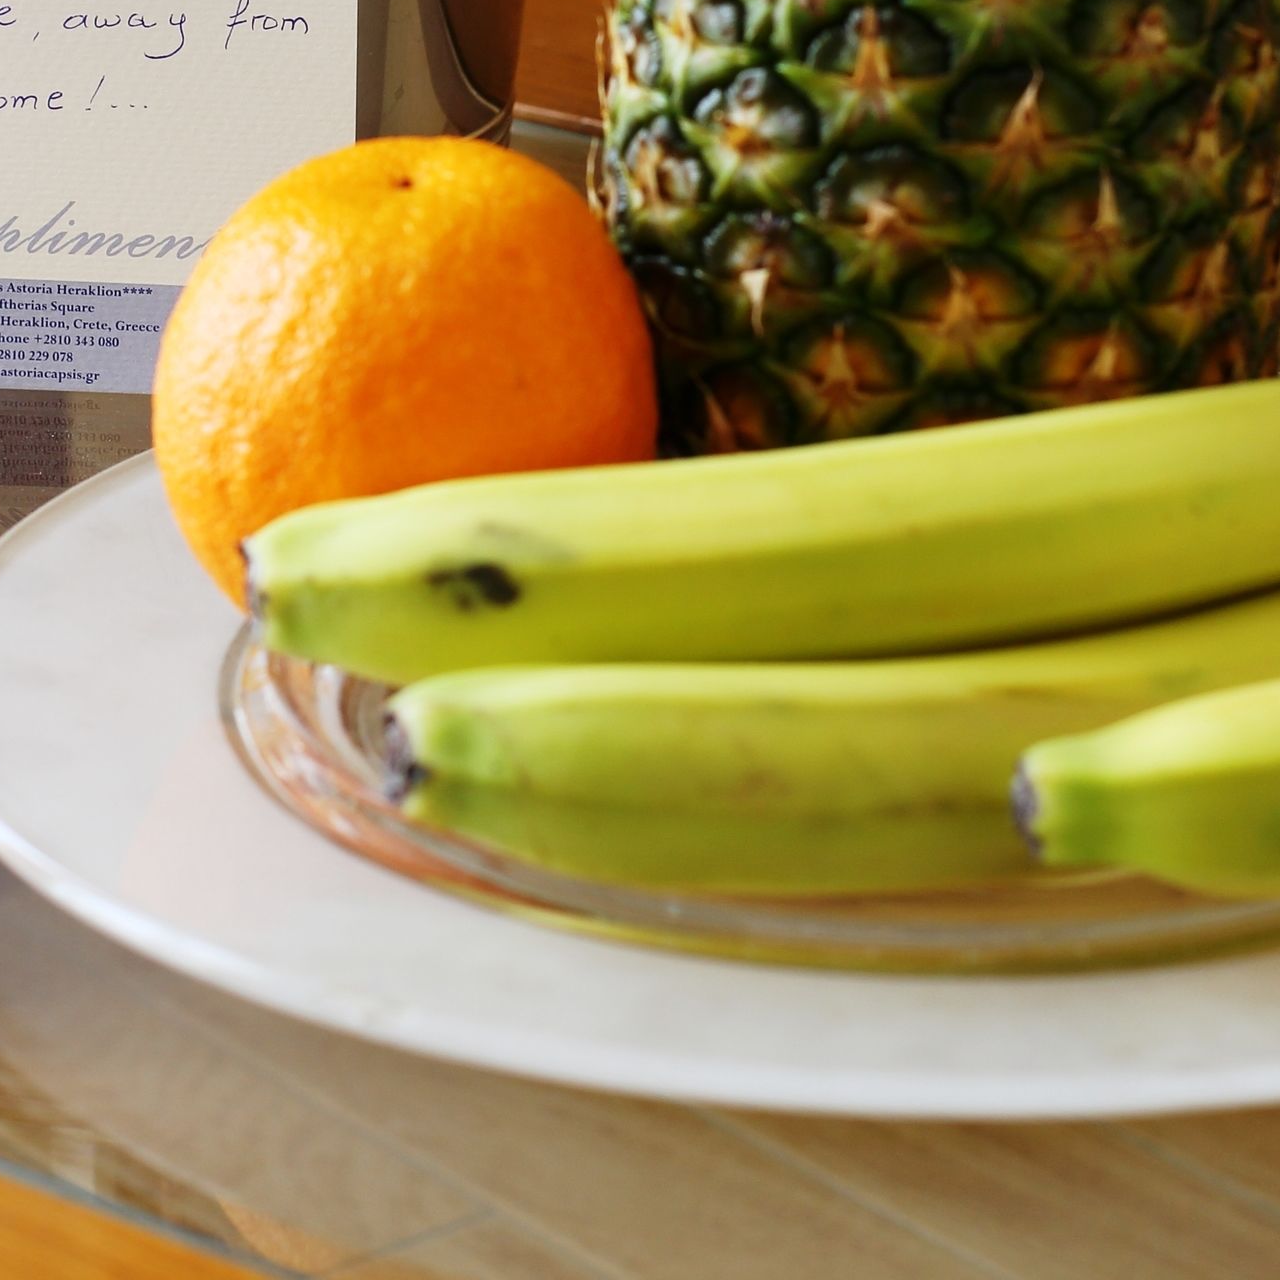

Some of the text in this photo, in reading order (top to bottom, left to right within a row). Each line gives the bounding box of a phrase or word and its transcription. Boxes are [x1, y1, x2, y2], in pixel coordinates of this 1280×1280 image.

[63, 10, 187, 59] away
[6, 283, 53, 295] Astoria
[50, 301, 95, 315] Square
[0, 316, 70, 330] Heraklion,
[73, 319, 112, 332] Crete,
[115, 320, 160, 332] Greece
[33, 334, 71, 345] +2810
[75, 335, 95, 346] 343
[98, 336, 120, 347] 080
[28, 351, 49, 361] 229
[52, 352, 73, 362] 078
